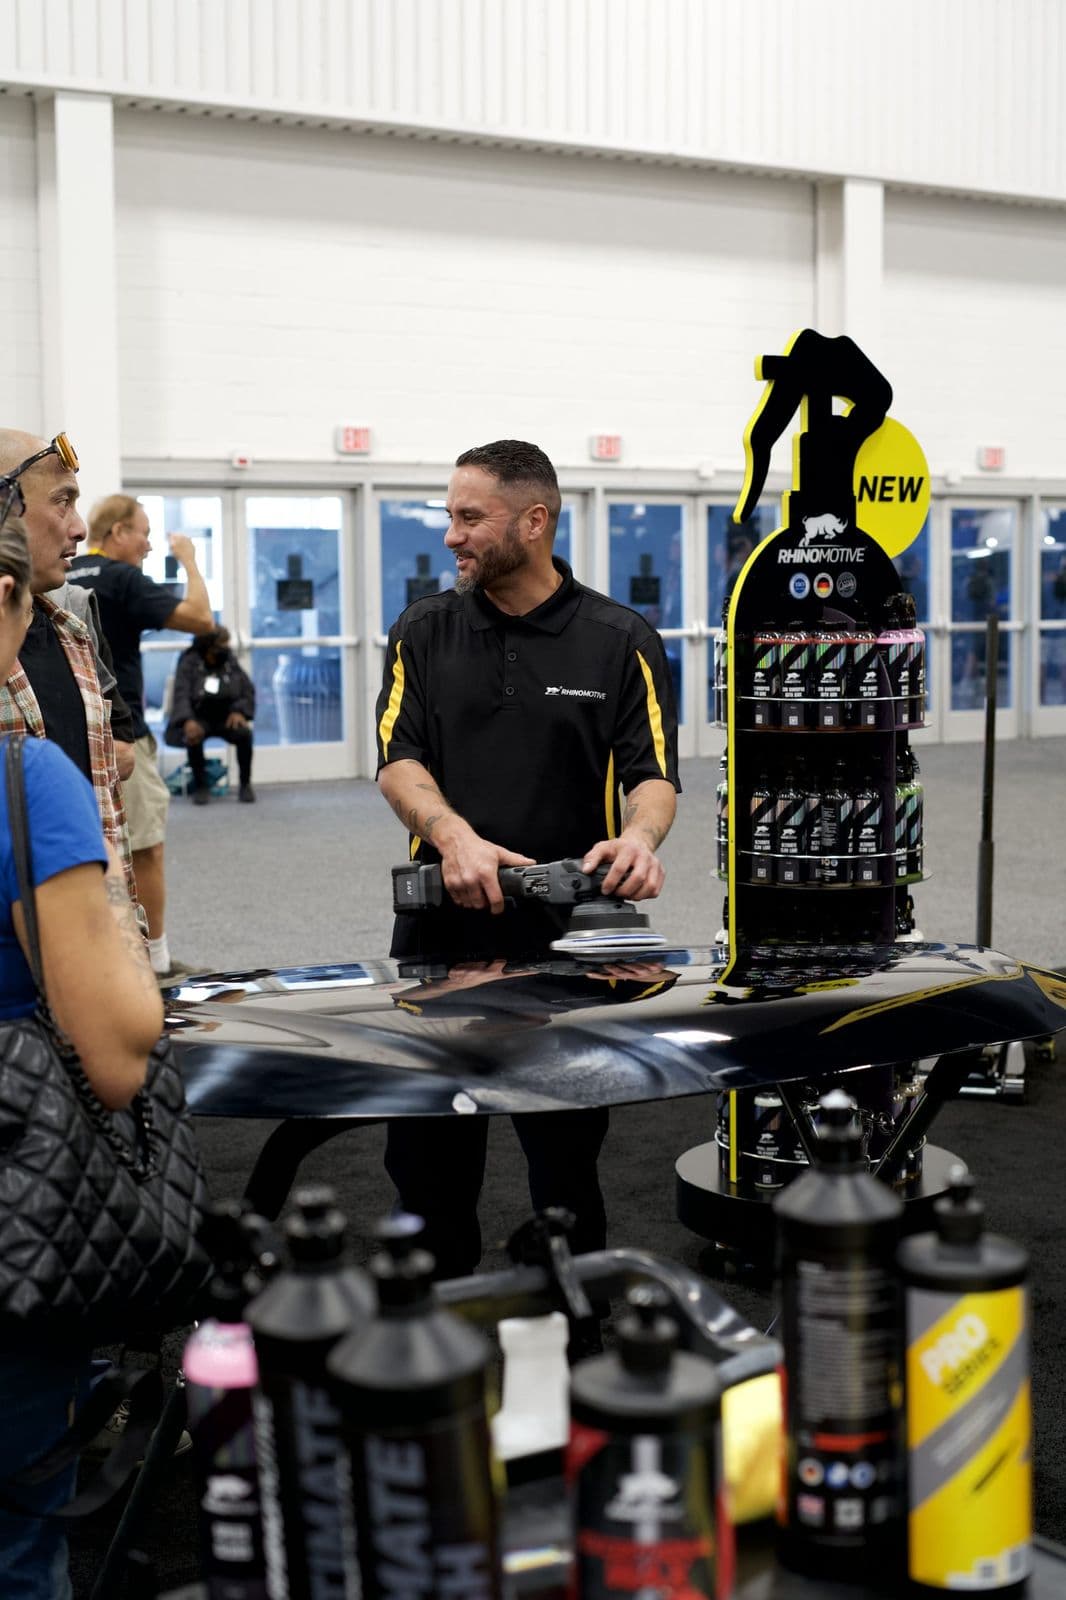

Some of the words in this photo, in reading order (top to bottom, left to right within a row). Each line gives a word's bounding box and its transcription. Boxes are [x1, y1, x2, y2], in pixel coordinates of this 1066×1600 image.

[858, 476, 925, 503] NEW
[777, 547, 865, 564] RHINOMOTIVE
[561, 688, 607, 700] RHINOMOTIVE
[920, 1313, 989, 1386] PRO
